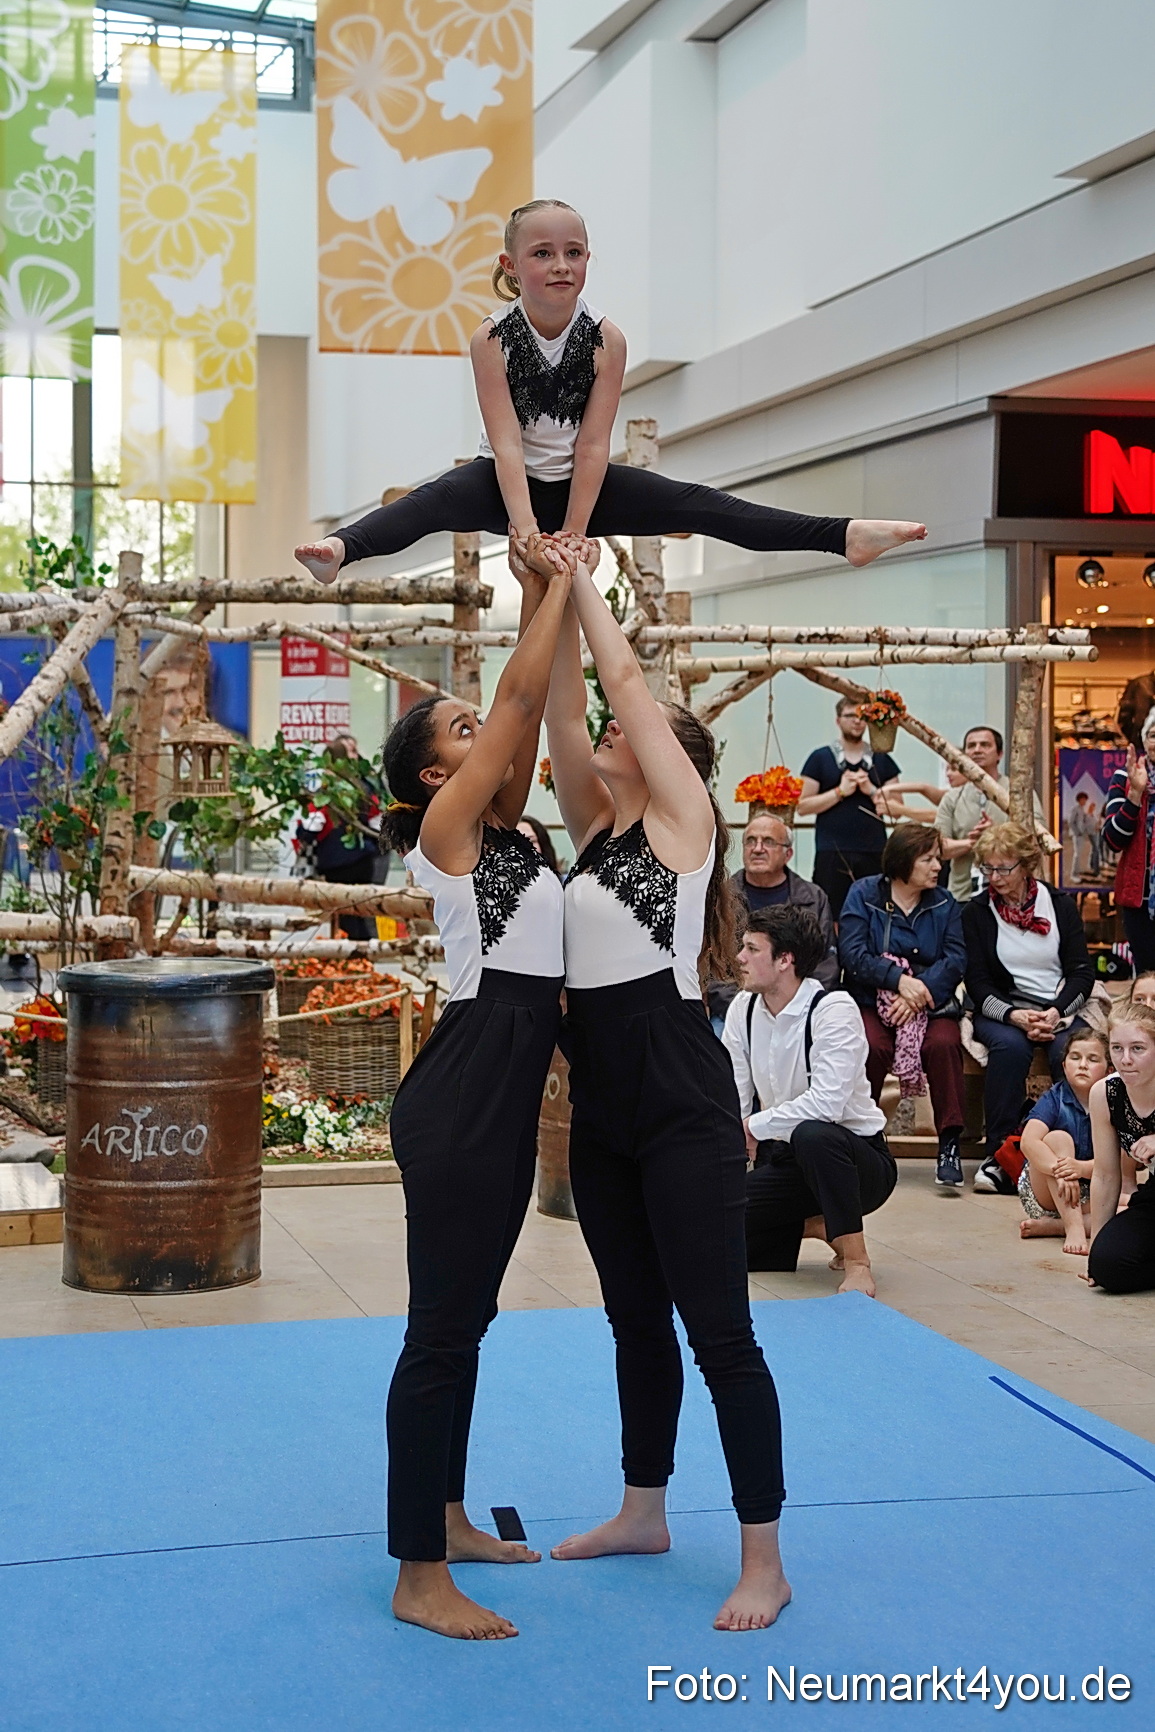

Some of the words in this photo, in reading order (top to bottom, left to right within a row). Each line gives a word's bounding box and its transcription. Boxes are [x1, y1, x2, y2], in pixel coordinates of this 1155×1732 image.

[1084, 429, 1155, 515] N
[281, 704, 324, 724] REWE
[281, 726, 324, 741] CENTER
